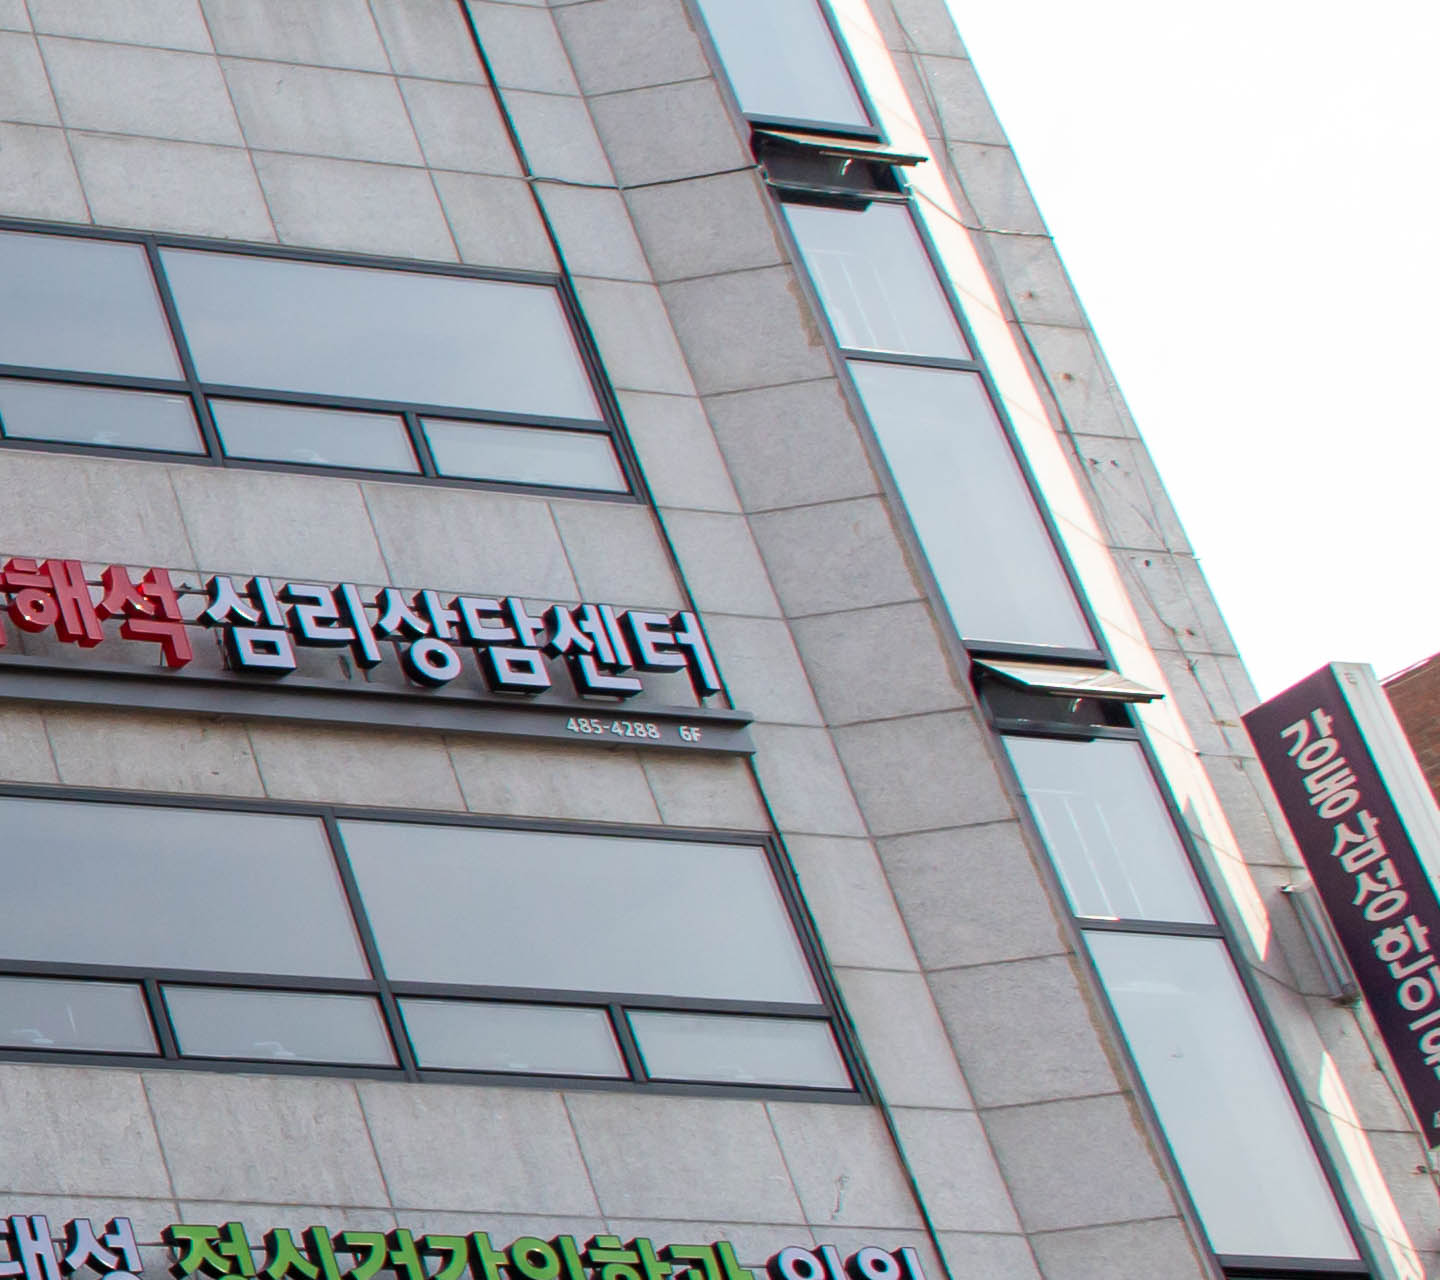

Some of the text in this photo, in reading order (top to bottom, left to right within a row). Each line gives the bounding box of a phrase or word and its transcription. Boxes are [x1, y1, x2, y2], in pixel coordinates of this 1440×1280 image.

[200, 575, 723, 704] 심리상담센터
[566, 716, 702, 743] 485-4288 6F
